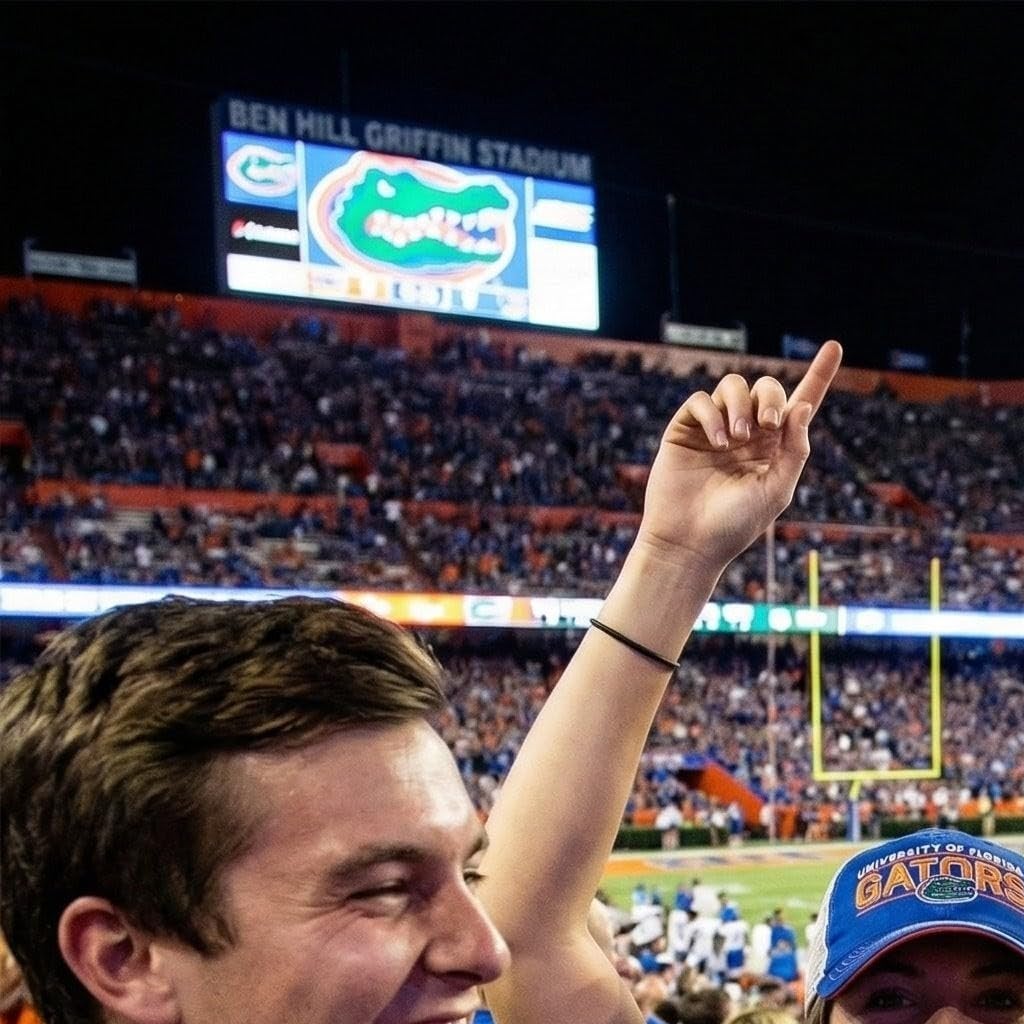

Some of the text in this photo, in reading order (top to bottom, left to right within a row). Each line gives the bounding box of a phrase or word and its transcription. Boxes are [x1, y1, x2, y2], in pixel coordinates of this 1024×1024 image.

[229, 98, 593, 182] BEN HILL GRIFFIN STADIUM
